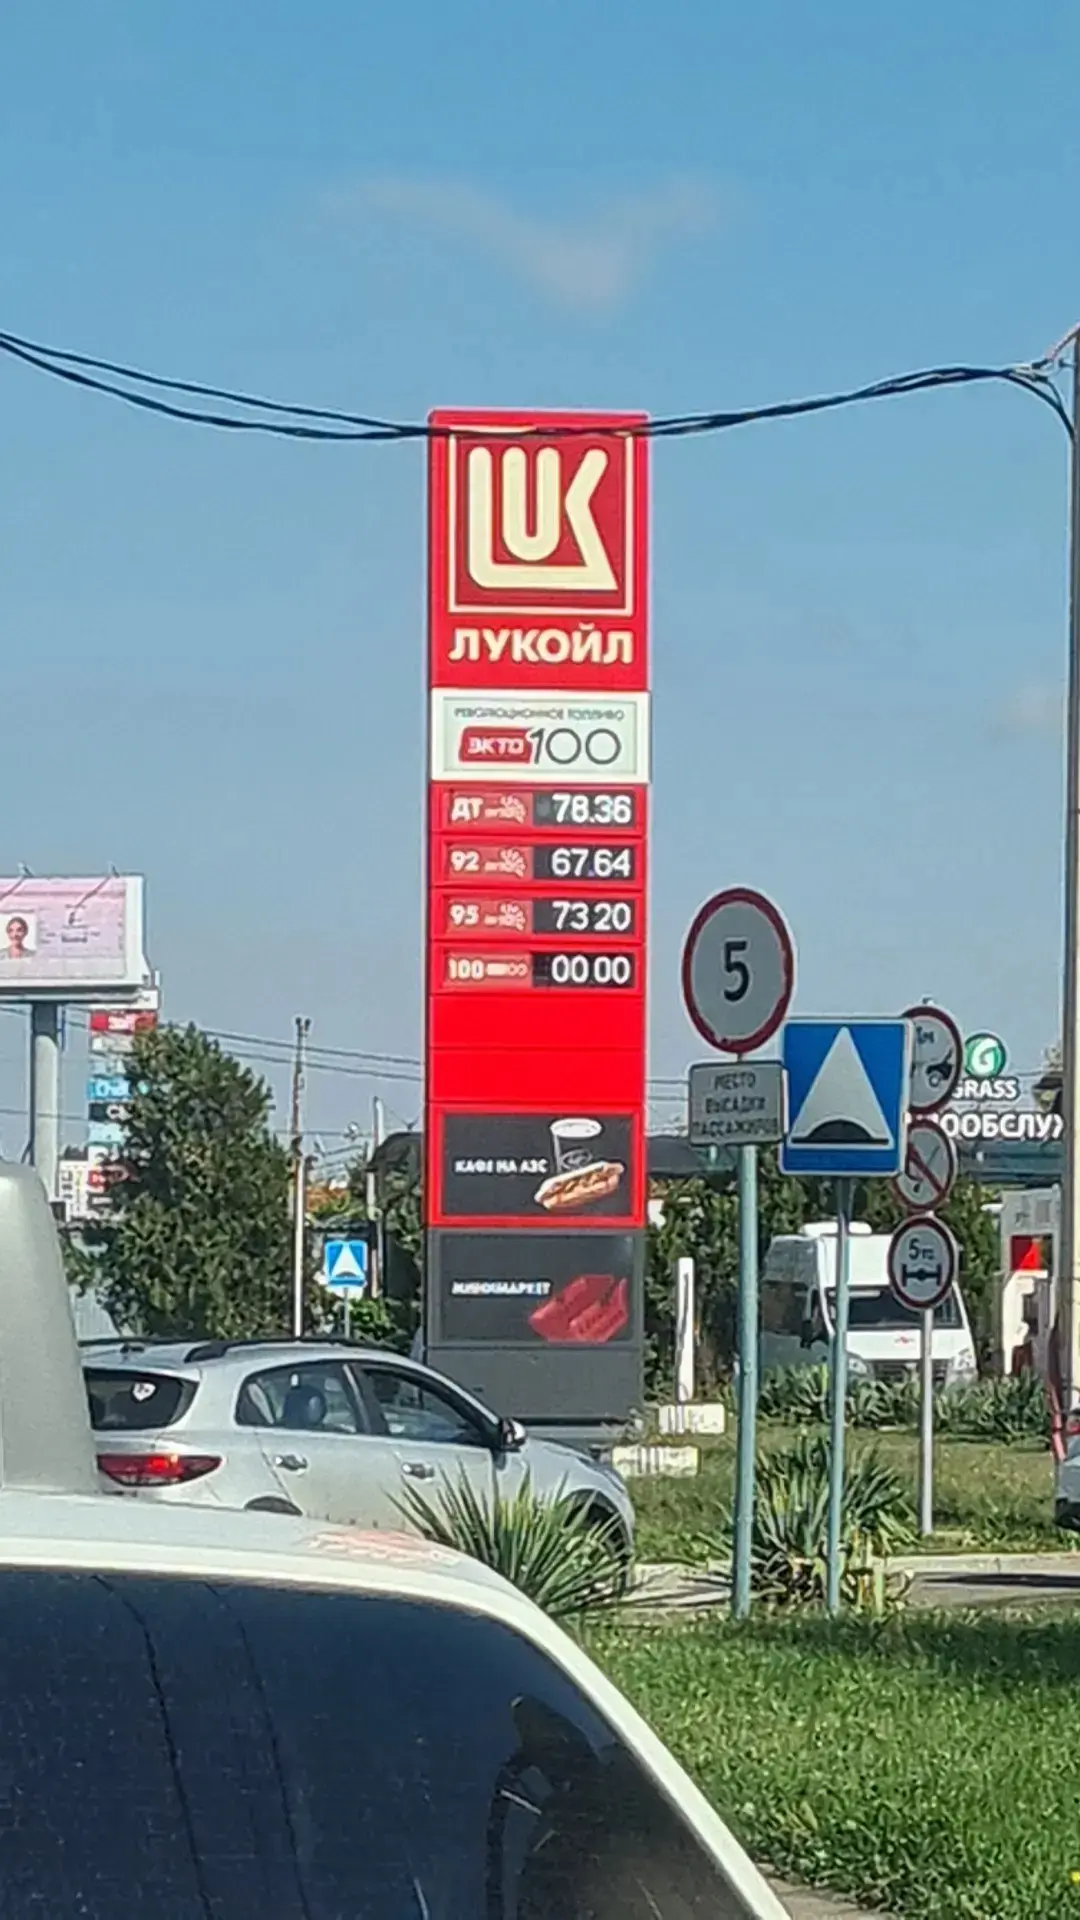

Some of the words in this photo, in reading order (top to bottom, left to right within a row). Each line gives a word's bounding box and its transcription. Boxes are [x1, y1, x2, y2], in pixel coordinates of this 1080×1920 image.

[449, 623, 633, 664] ЛУКОЙЛ
[468, 736, 524, 755] ЭКТО
[530, 728, 622, 765] 100
[451, 797, 483, 821] ДТ
[552, 793, 632, 823] 78.36
[450, 851, 480, 871] 92
[551, 848, 630, 877] 67.64
[450, 904, 479, 925] 95
[448, 959, 484, 979] 100
[723, 940, 750, 1002] 5
[714, 1072, 756, 1090] МЕСТО
[496, 1159, 518, 1174] НА
[520, 1159, 549, 1174] АЗС
